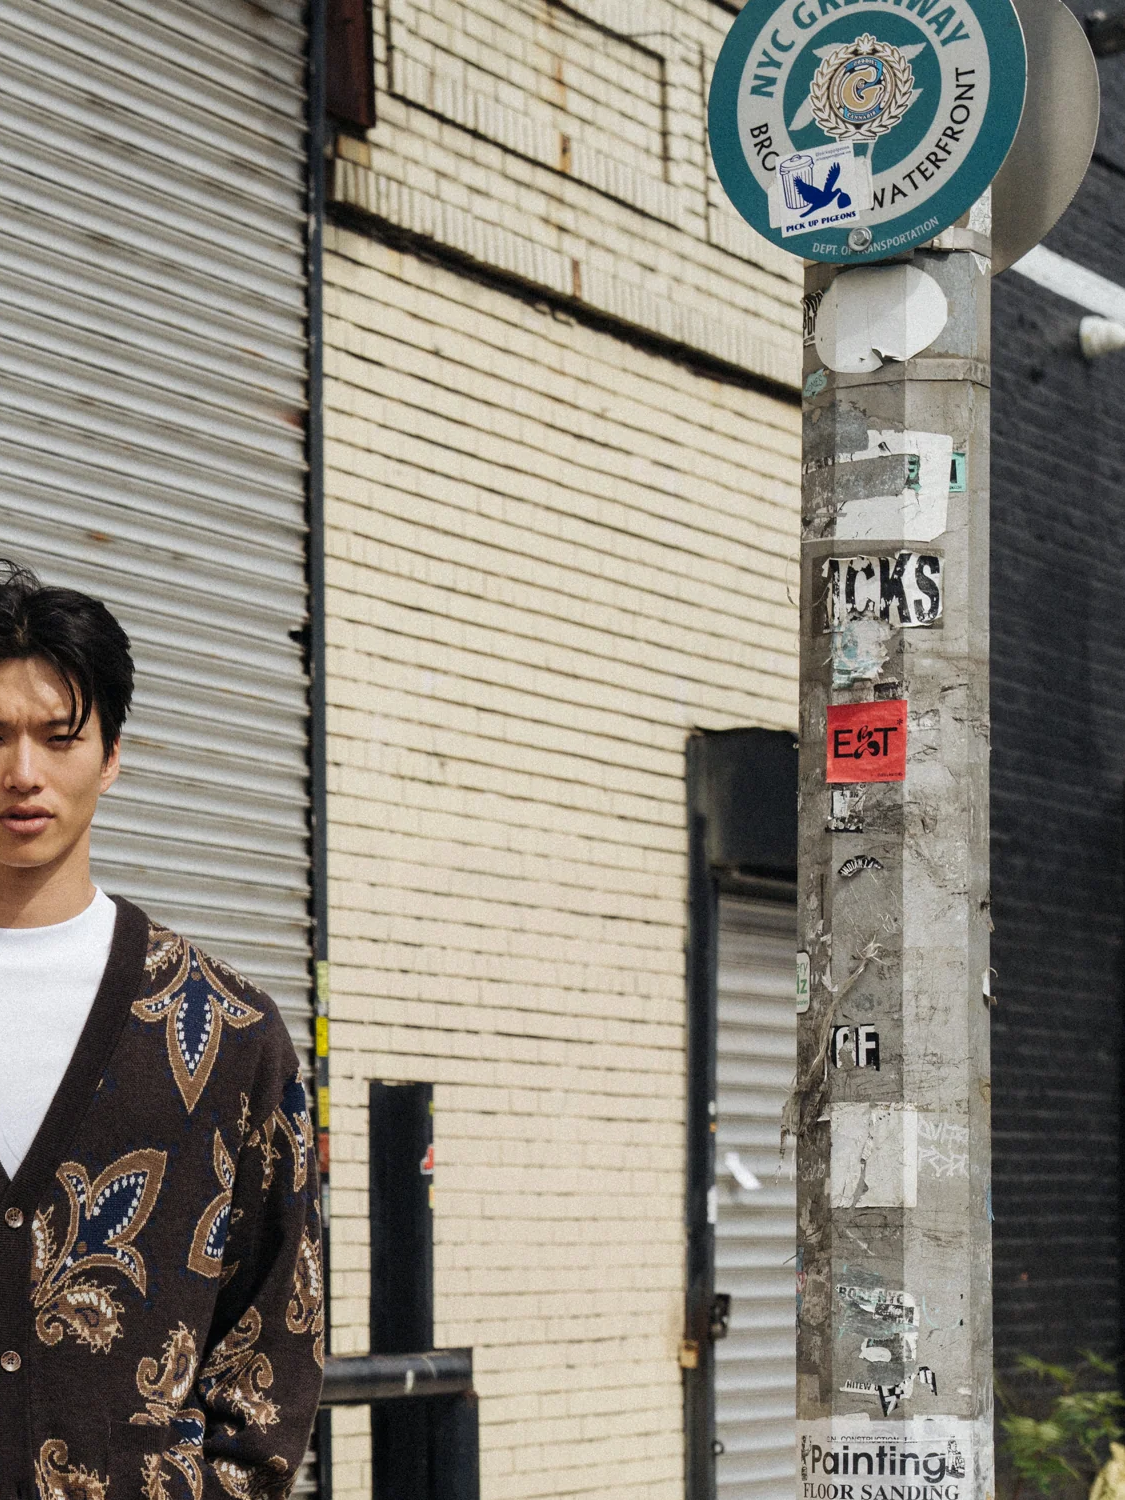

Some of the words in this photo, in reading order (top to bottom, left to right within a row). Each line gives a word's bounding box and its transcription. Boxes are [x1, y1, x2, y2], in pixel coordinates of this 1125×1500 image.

[750, 28, 795, 98] NYC
[871, 67, 975, 211] WATERFRONT
[786, 223, 806, 232] PICK
[808, 218, 818, 227] UP
[821, 211, 856, 224] PIGEONS
[812, 242, 838, 255] DEPT.
[811, 1445, 945, 1483] Painting
[804, 1483, 854, 1500] FLOOR
[860, 1485, 960, 1500] SANDING
